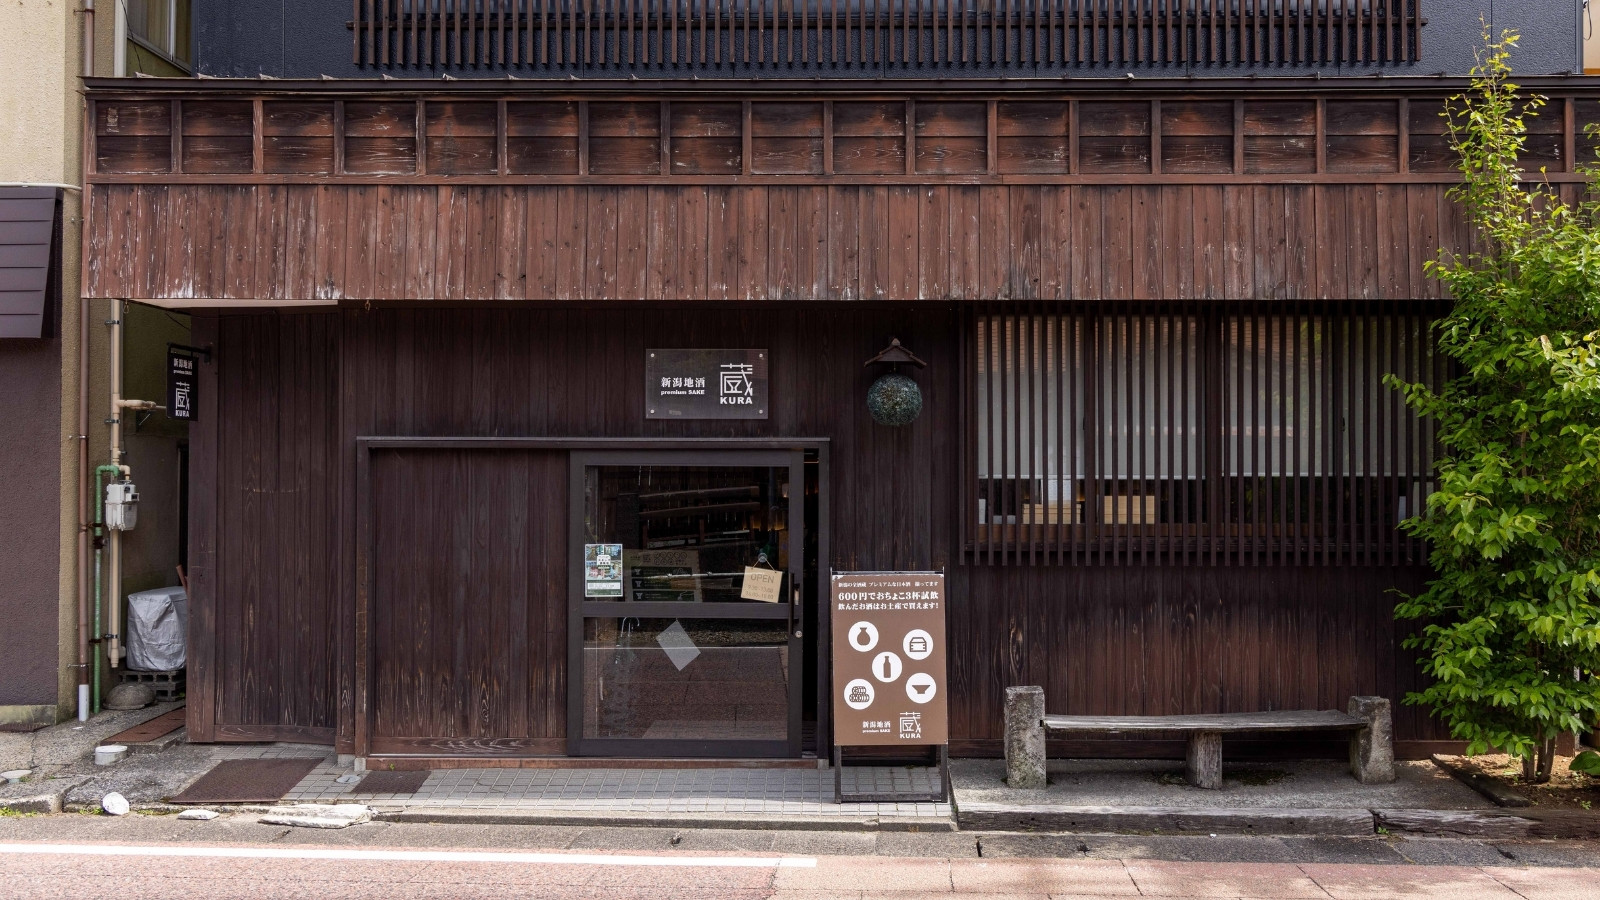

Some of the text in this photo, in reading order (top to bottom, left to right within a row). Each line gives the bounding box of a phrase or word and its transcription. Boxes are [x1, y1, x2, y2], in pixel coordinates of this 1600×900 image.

[174, 358, 193, 369] 新潟地酒
[661, 377, 705, 388] 新潟地酒
[750, 573, 775, 584] OPEN
[838, 591, 939, 601] 600円でおちょこ3杯試飲
